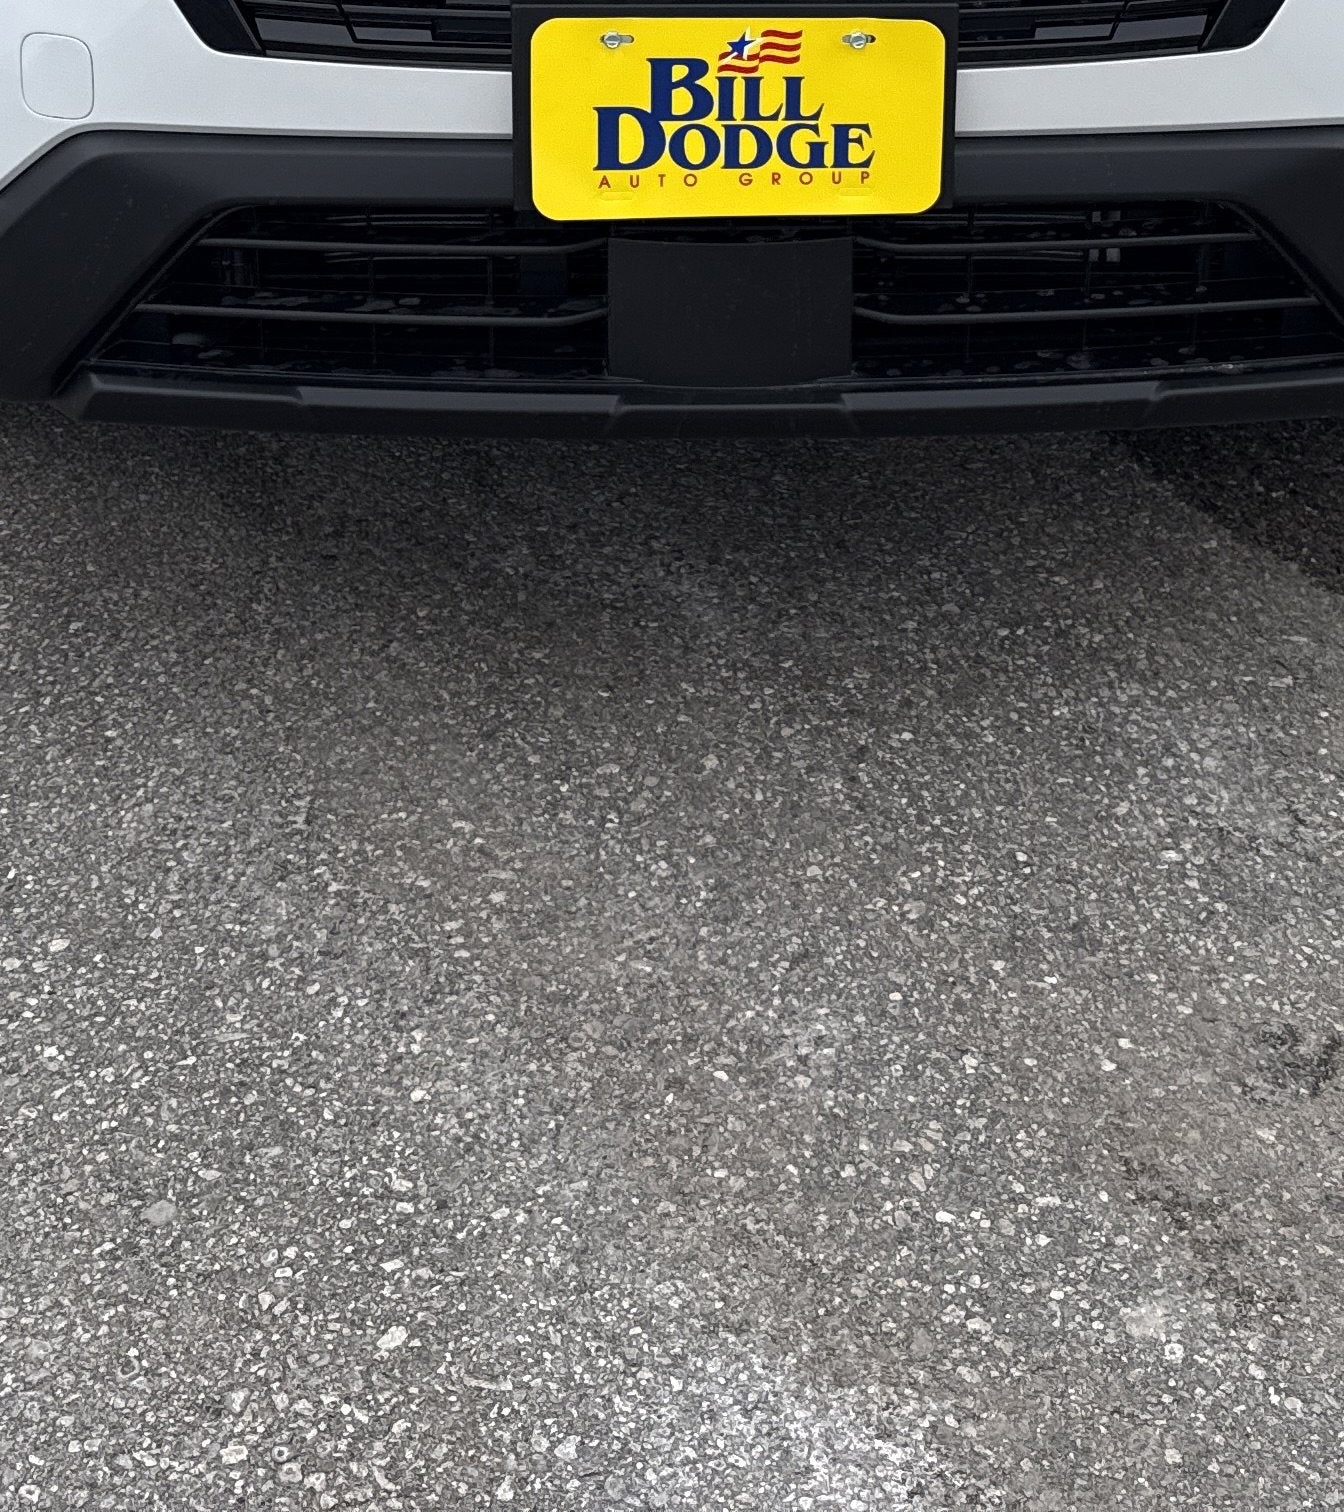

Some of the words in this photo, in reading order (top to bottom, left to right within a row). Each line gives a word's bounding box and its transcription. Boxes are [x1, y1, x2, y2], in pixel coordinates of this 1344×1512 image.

[646, 57, 824, 122] BILL
[593, 106, 876, 171] DODGE
[598, 173, 697, 189] AUTO
[738, 171, 871, 186] GROUP
